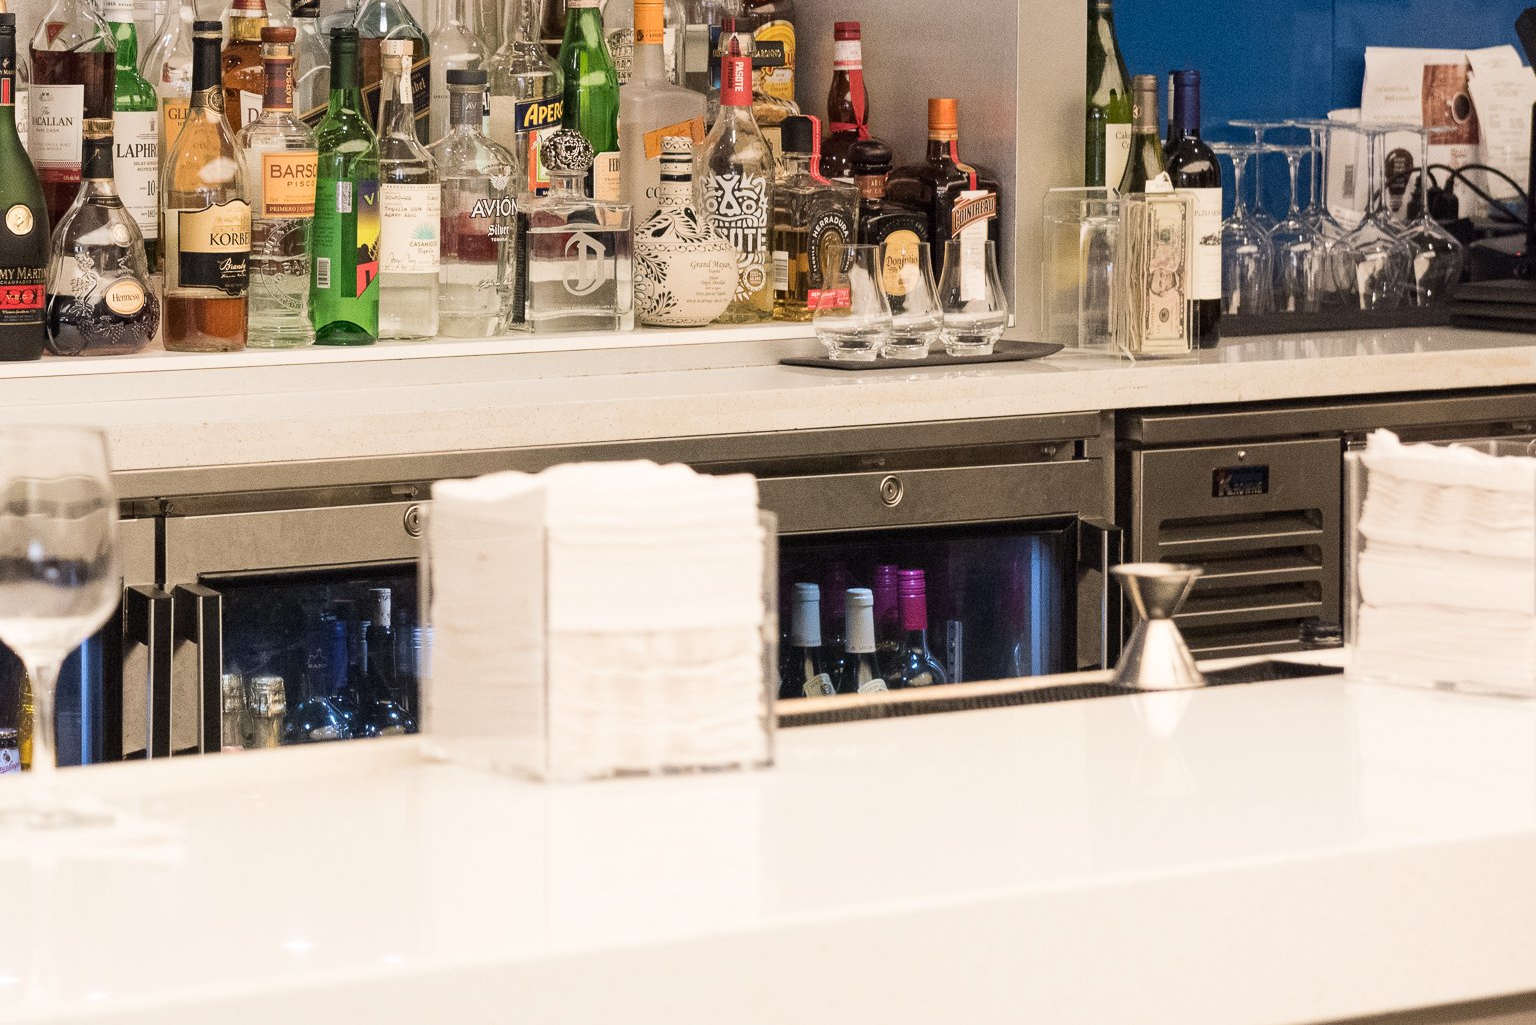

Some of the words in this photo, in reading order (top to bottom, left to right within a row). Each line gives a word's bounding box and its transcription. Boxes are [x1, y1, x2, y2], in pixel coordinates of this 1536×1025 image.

[735, 61, 744, 92] PASOTE
[147, 180, 155, 195] 10
[269, 205, 296, 213] PRIMERO
[470, 195, 518, 218] AVIÓN
[954, 198, 994, 230] COINTREAU
[488, 224, 510, 237] Silver
[812, 216, 849, 237] HERRADURA
[219, 257, 247, 272] Brandy
